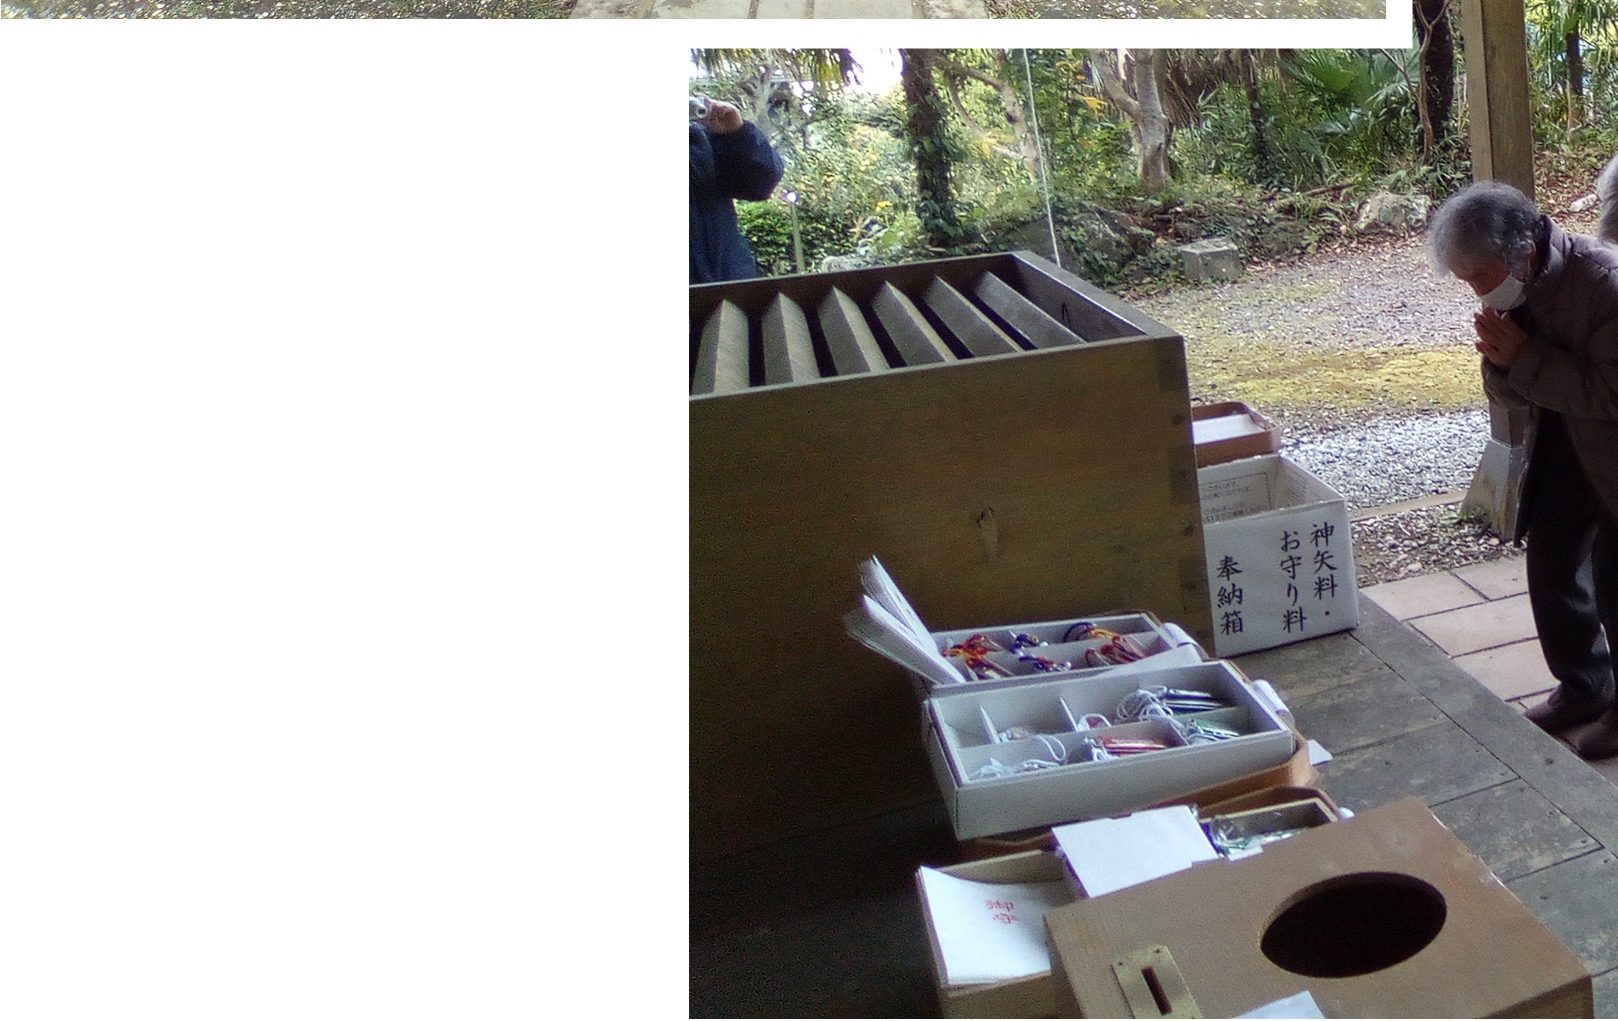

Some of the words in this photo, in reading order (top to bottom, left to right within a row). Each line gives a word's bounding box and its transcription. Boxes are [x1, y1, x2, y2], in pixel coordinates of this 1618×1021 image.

[1216, 555, 1244, 636] 奉納箱
[1279, 530, 1307, 634] お守り料
